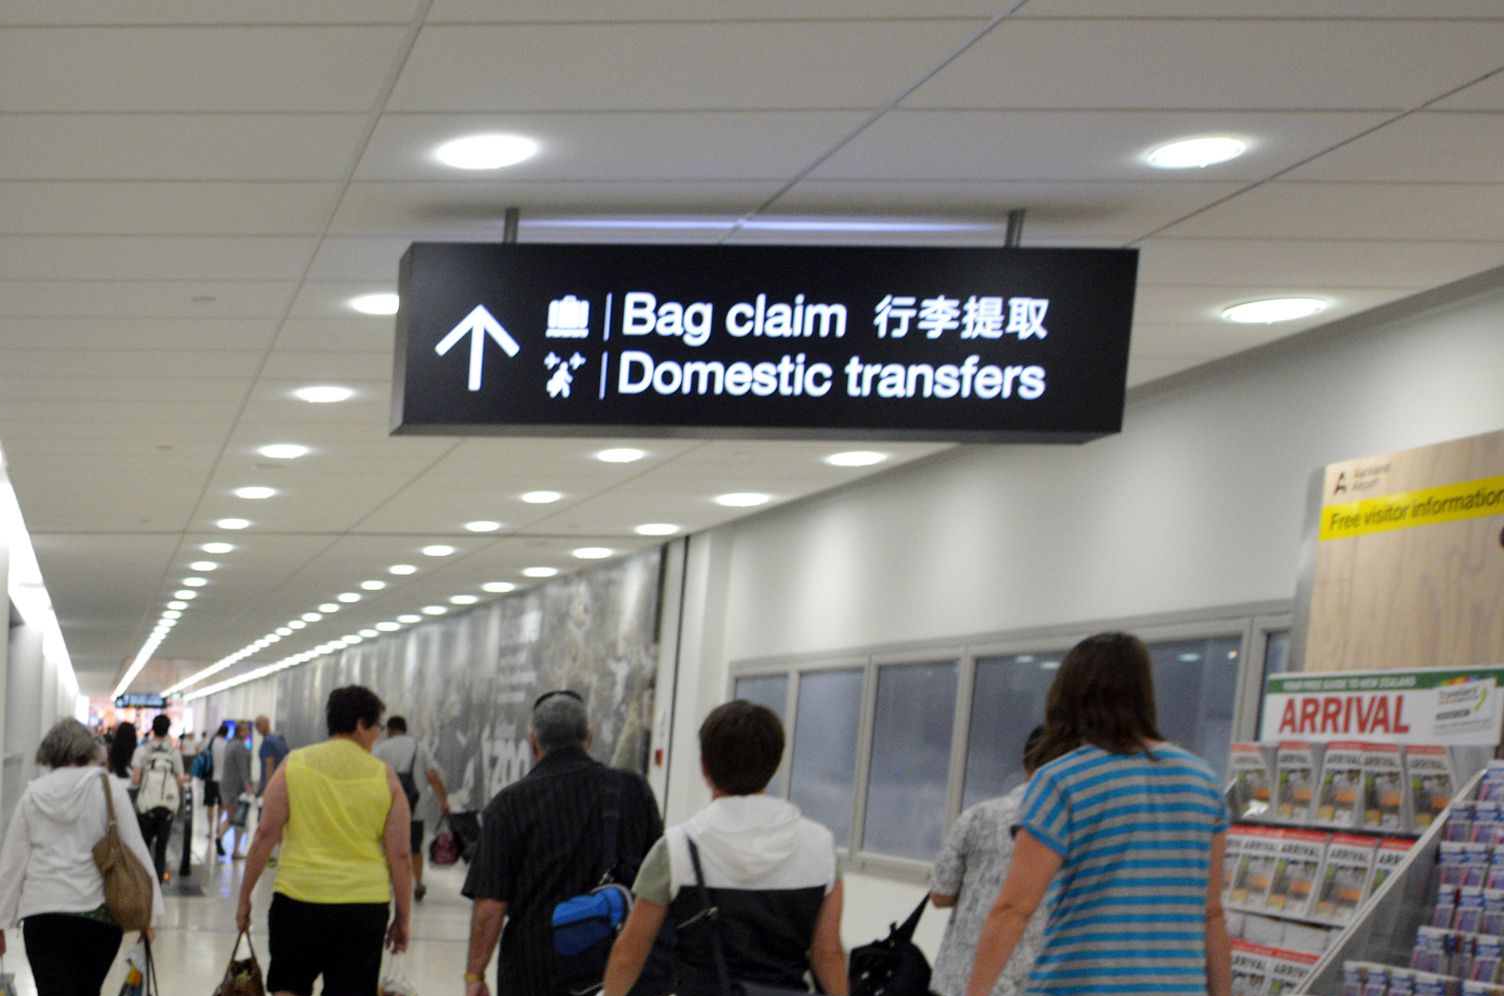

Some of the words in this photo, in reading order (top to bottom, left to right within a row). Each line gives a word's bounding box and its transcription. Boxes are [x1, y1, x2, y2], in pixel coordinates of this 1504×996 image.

[622, 291, 713, 347] Bag
[725, 293, 847, 339] claim
[873, 293, 1049, 341] 行李提取
[618, 350, 833, 397] Domestic
[844, 353, 1046, 400] transfers
[1329, 510, 1361, 532] Free
[1363, 503, 1409, 526] visitor
[1279, 694, 1411, 734] ARRIVAL
